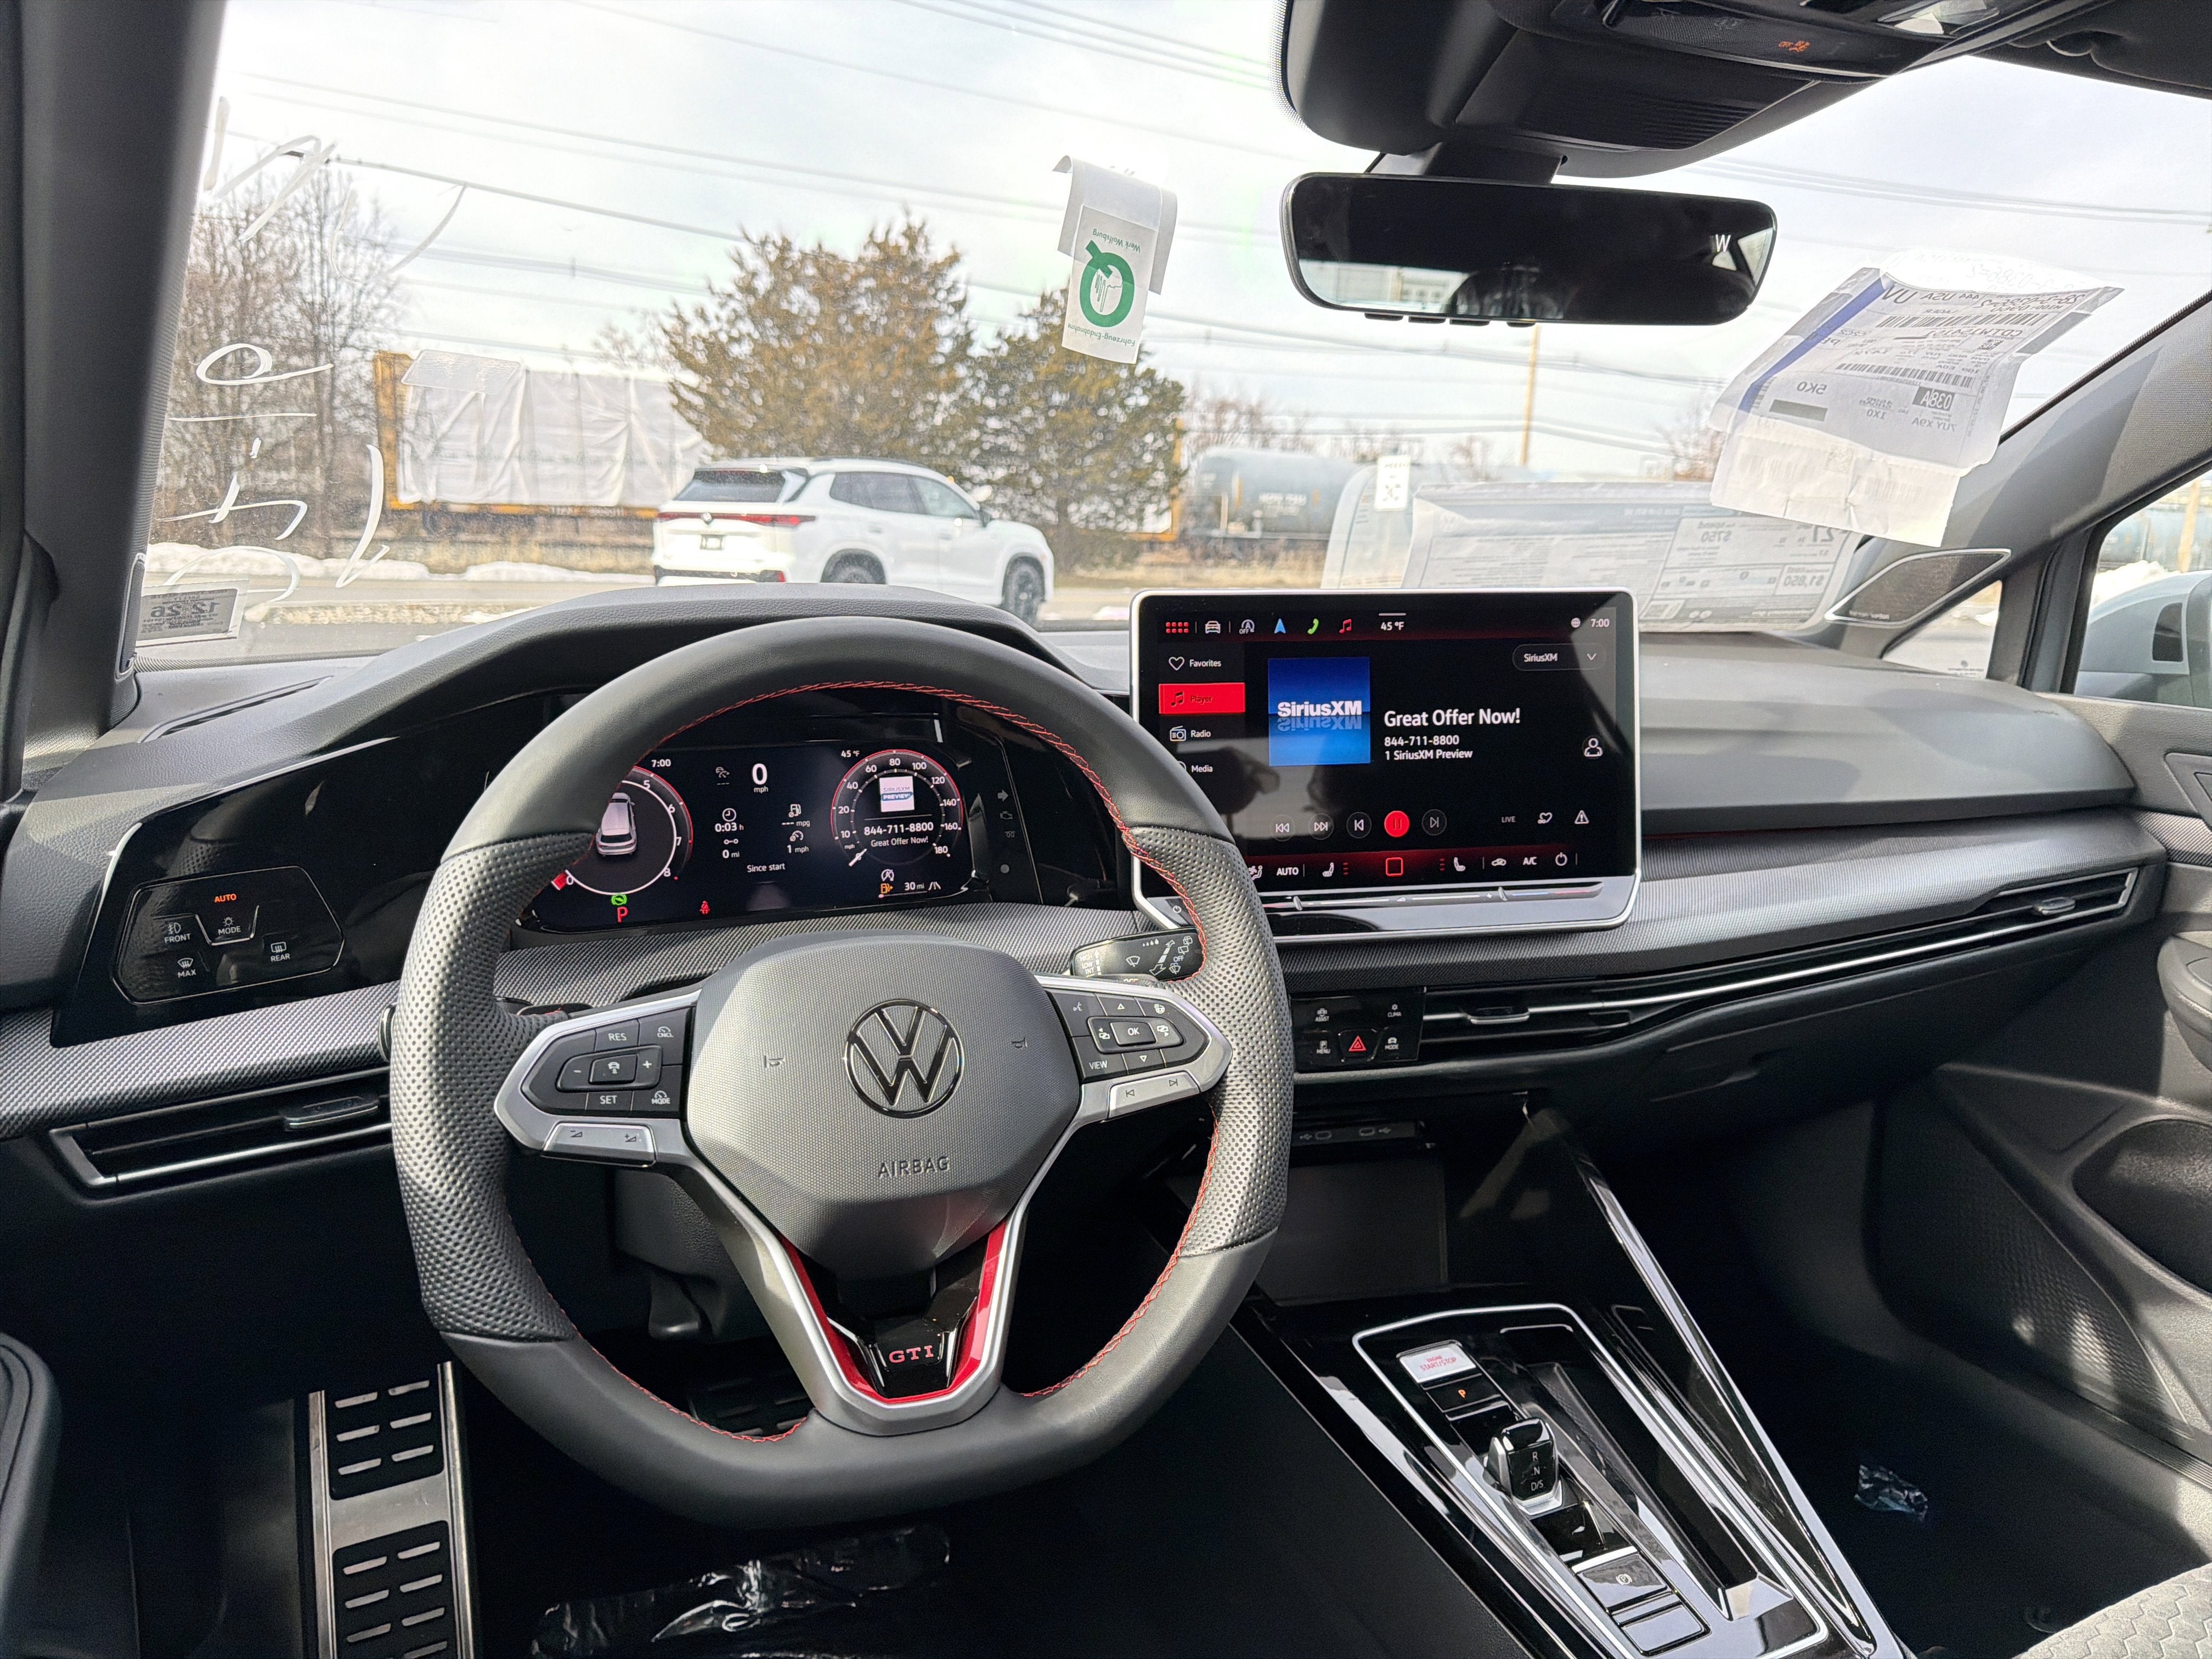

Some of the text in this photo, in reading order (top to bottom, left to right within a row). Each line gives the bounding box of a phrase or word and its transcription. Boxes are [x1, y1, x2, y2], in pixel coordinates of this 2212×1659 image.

[1092, 228, 1141, 253] Werk Wolfsburg
[1715, 234, 1730, 252] W
[1068, 323, 1136, 347] Fahrzeug-Endabnahme
[1380, 622, 1392, 631] 45
[1590, 618, 1610, 628] 7:00
[1523, 652, 1558, 663] SiriusXM
[1189, 659, 1222, 668] Favorites
[1189, 694, 1214, 704] Player
[1277, 700, 1362, 718] SiriusXM
[1384, 707, 1521, 727] Great Offer Now!
[1190, 729, 1211, 738] Radio
[1384, 735, 1460, 747] 844-711-8800
[840, 749, 851, 758] 45
[1385, 748, 1473, 761] 1 SiriusXM Preview
[651, 758, 672, 768] 7:00
[889, 758, 901, 767] 80
[912, 761, 927, 770] 100
[865, 764, 877, 774] 60
[1191, 764, 1214, 773] Media
[752, 763, 768, 785] 0
[644, 779, 651, 789] 5
[847, 781, 859, 790] 40
[932, 776, 945, 785] 120
[943, 798, 957, 807] 140
[668, 804, 676, 814] 6
[838, 805, 850, 815] 20
[1501, 815, 1516, 823] LIVE
[715, 822, 737, 832] 0:03
[863, 822, 934, 836] 844-711-8800
[945, 822, 959, 831] 160
[840, 830, 851, 839] 10
[676, 837, 682, 847] 7
[871, 837, 929, 848] Great Offer Now!
[787, 845, 809, 854] 1 mph
[934, 845, 949, 854] 180
[722, 850, 730, 860] 0
[1522, 856, 1538, 866] A/C
[663, 867, 670, 877] 8
[747, 863, 786, 873] Since start
[1276, 866, 1299, 876] AUTO
[566, 876, 574, 885] 0
[904, 882, 916, 891] 30
[214, 893, 238, 904] AUTO
[617, 906, 629, 923] P
[218, 926, 241, 935] MODE
[164, 933, 191, 944] FRONT
[270, 953, 291, 963] REAR
[1080, 953, 1093, 962] HIGH
[1081, 961, 1094, 969] LOW
[177, 969, 197, 979] MAX
[1127, 1027, 1141, 1036] OK
[608, 1032, 627, 1042] RES
[1089, 1060, 1108, 1070] VIEW
[600, 1096, 618, 1105] SET
[878, 1155, 950, 1179] AIRBAG
[889, 1345, 934, 1364] GTI
[1532, 1451, 1538, 1462] R
[1533, 1466, 1541, 1475] N
[1531, 1479, 1544, 1492] D/S
